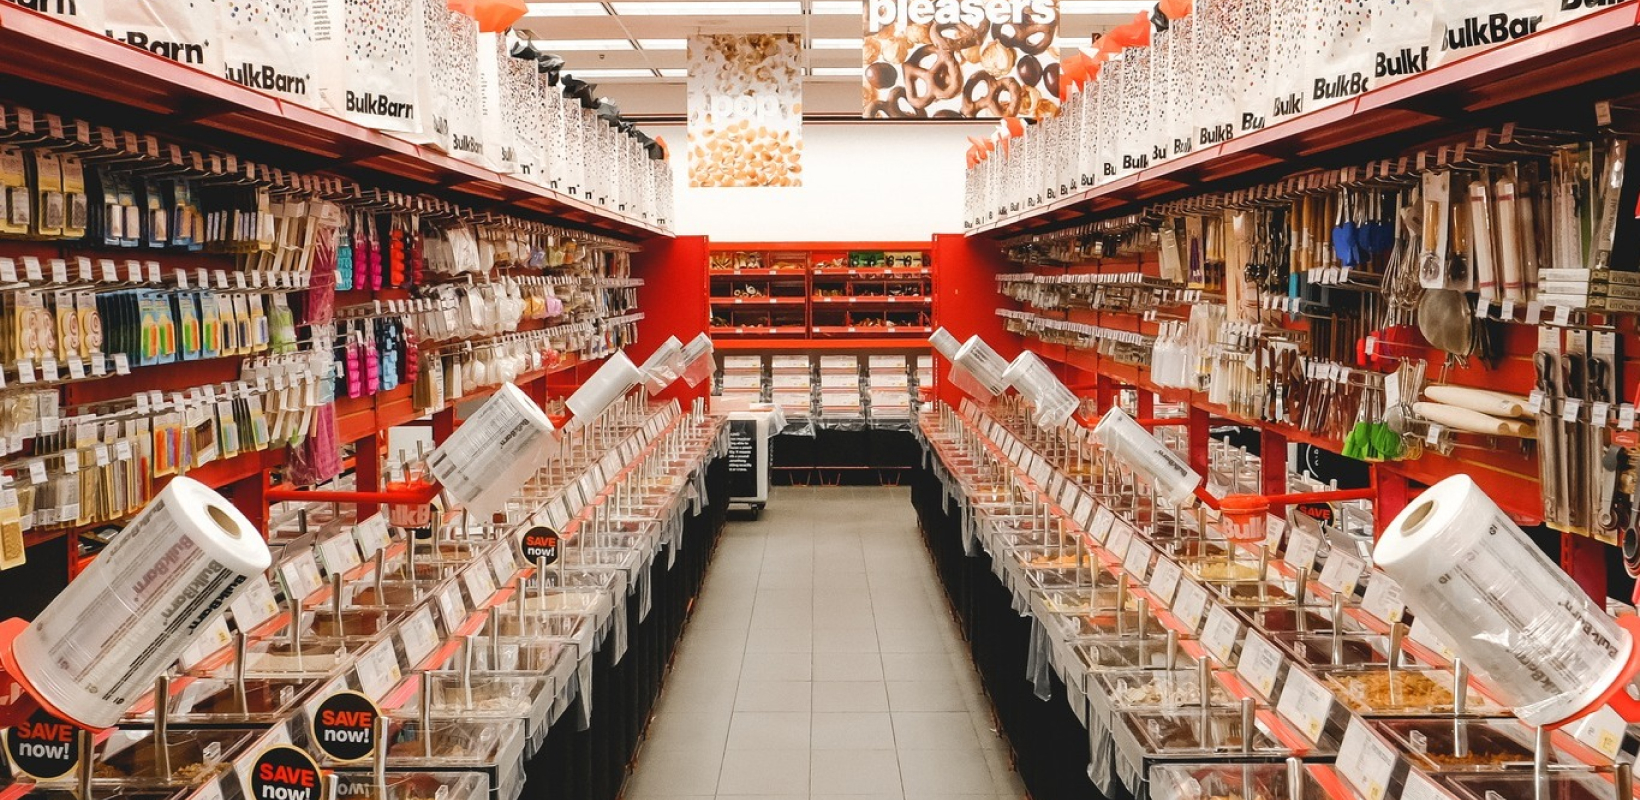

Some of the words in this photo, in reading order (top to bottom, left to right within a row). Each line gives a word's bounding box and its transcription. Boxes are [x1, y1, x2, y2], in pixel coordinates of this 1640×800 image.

[870, 0, 1056, 33] pleasers
[345, 89, 414, 120] BulkBarn
[711, 93, 779, 124] pop
[526, 535, 557, 548] SAVE
[132, 534, 194, 596] BulkBarn
[161, 558, 223, 621] BulkBarn
[189, 574, 247, 634] BulkBarn
[17, 721, 73, 742] SAVE
[322, 710, 372, 728] SAVE
[324, 728, 370, 743] now!
[19, 742, 70, 760] now!
[260, 762, 315, 788] SAVE
[262, 784, 312, 800] now!
